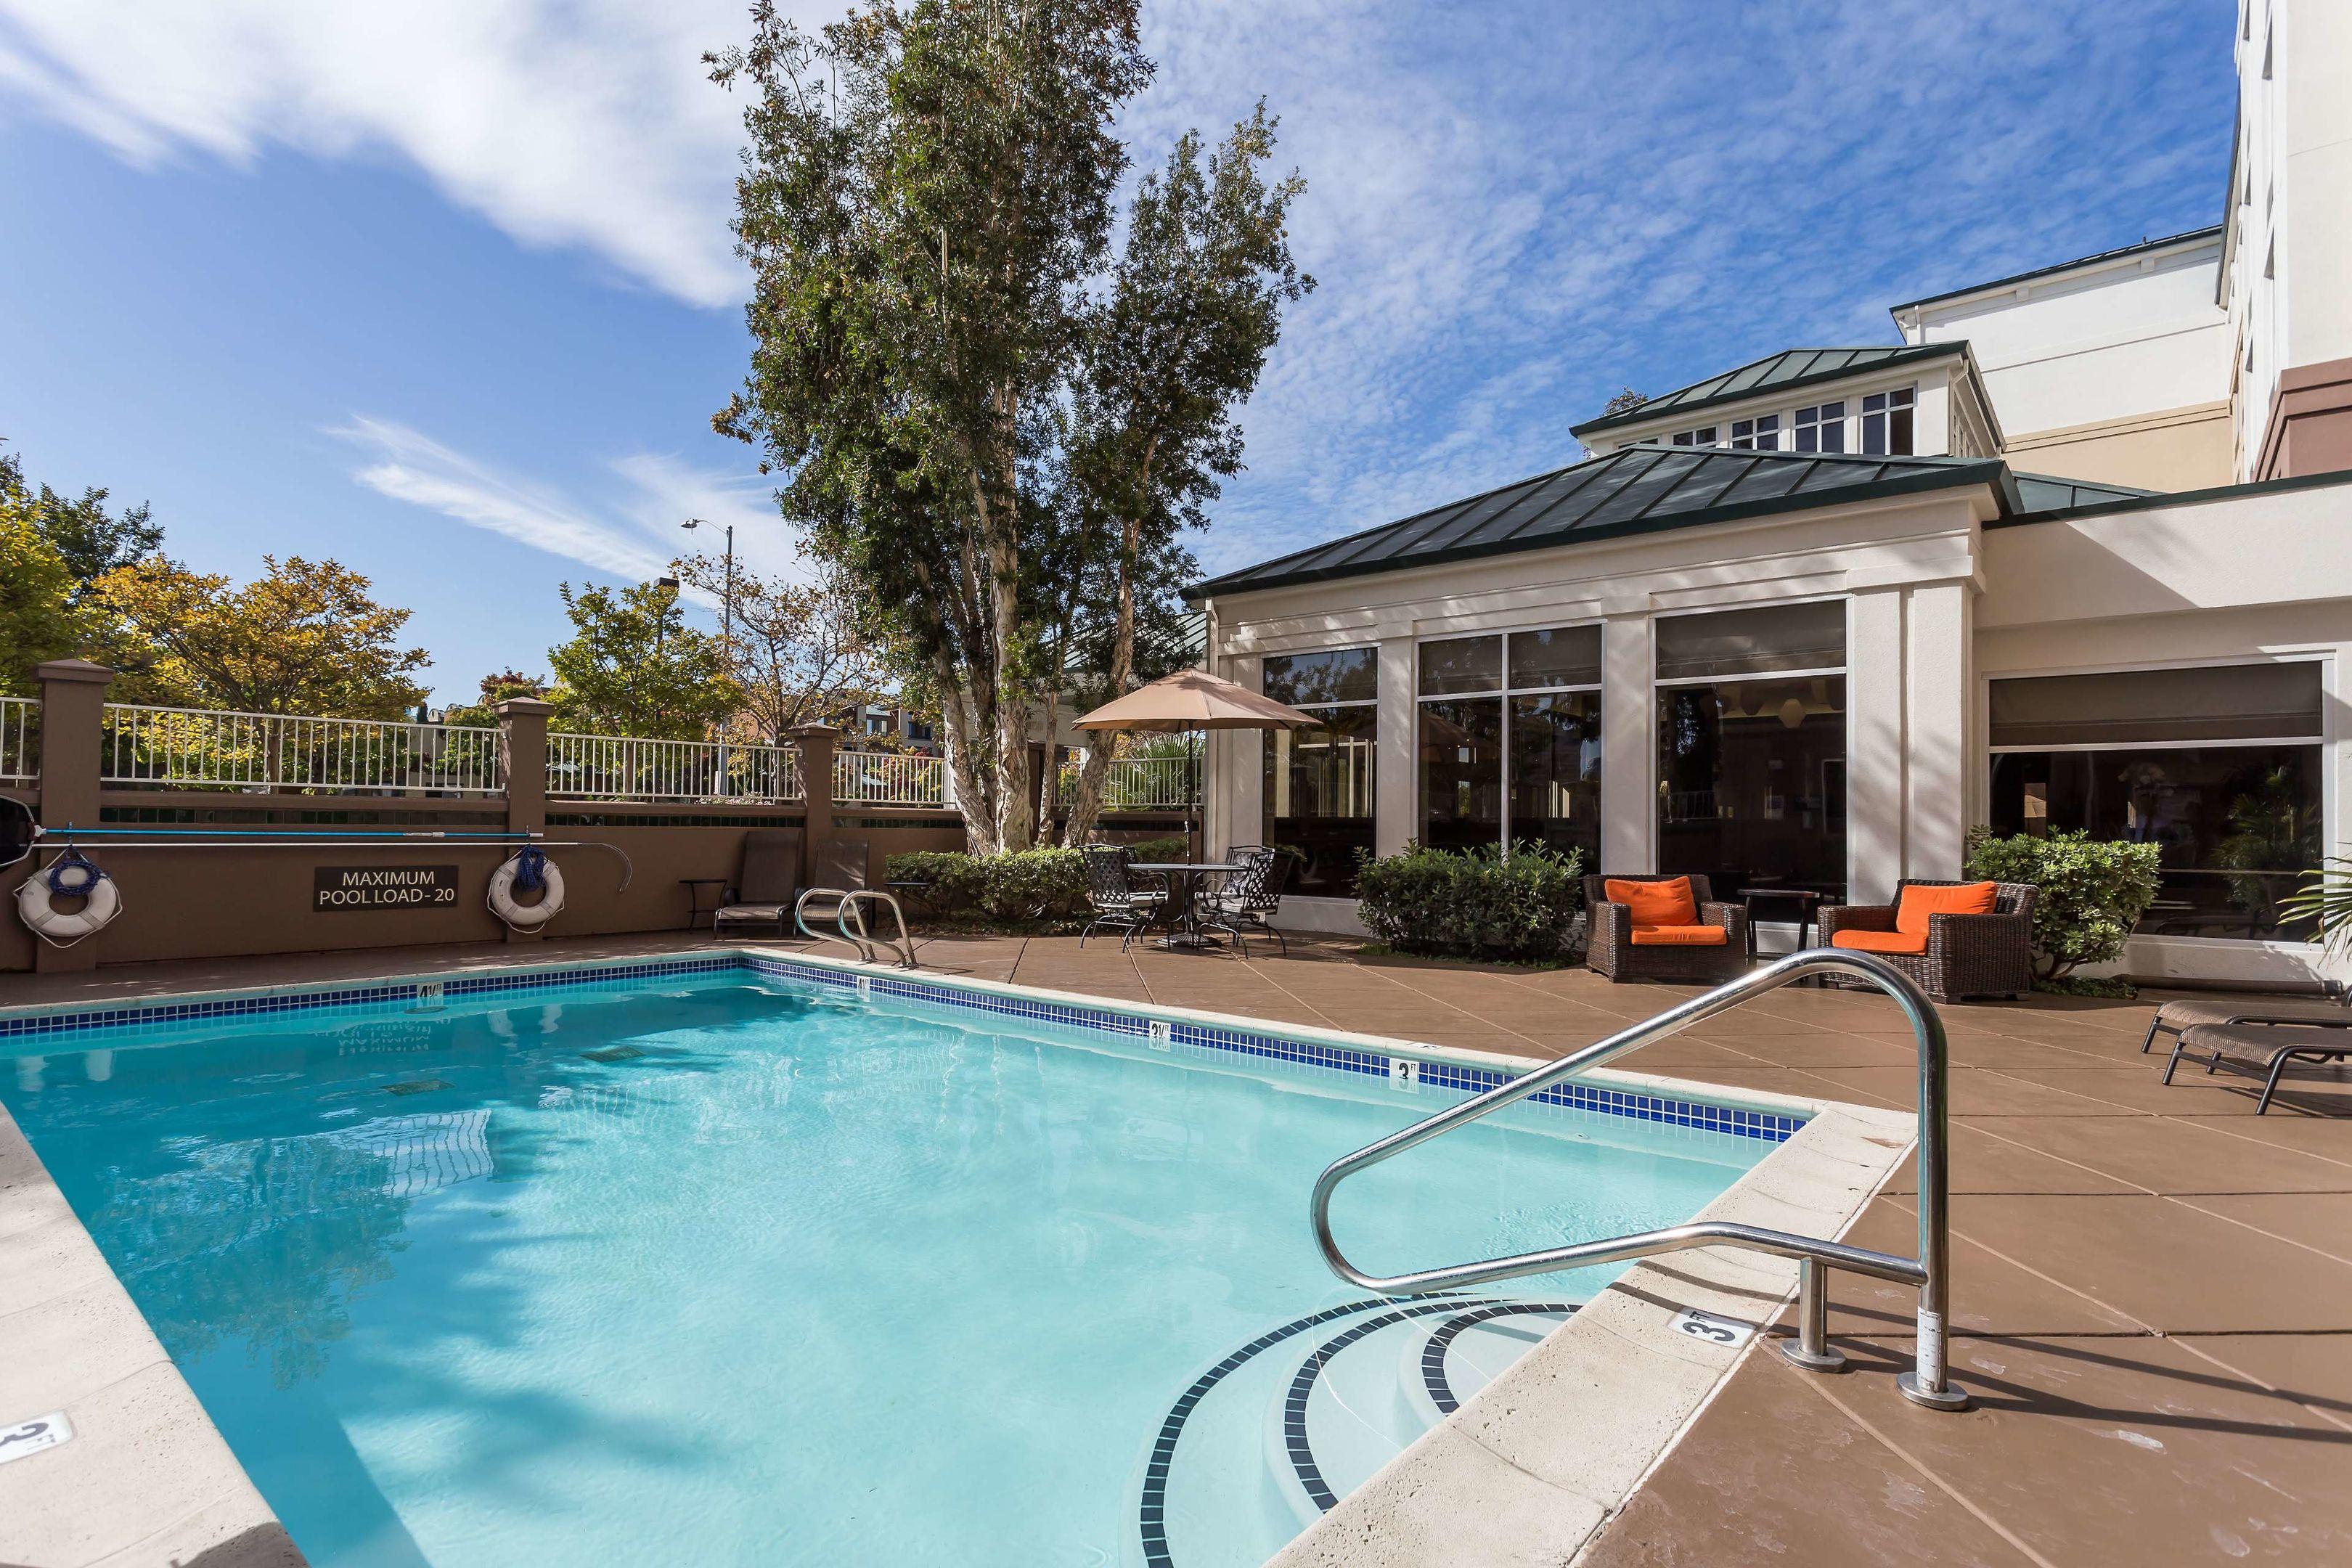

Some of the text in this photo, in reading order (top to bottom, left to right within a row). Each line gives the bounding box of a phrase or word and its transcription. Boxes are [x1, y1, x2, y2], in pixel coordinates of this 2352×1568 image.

[343, 871, 434, 886] MAXIMUM
[319, 890, 371, 905] POOL
[434, 888, 454, 902] 20
[1682, 1310, 1736, 1342] 3 FT
